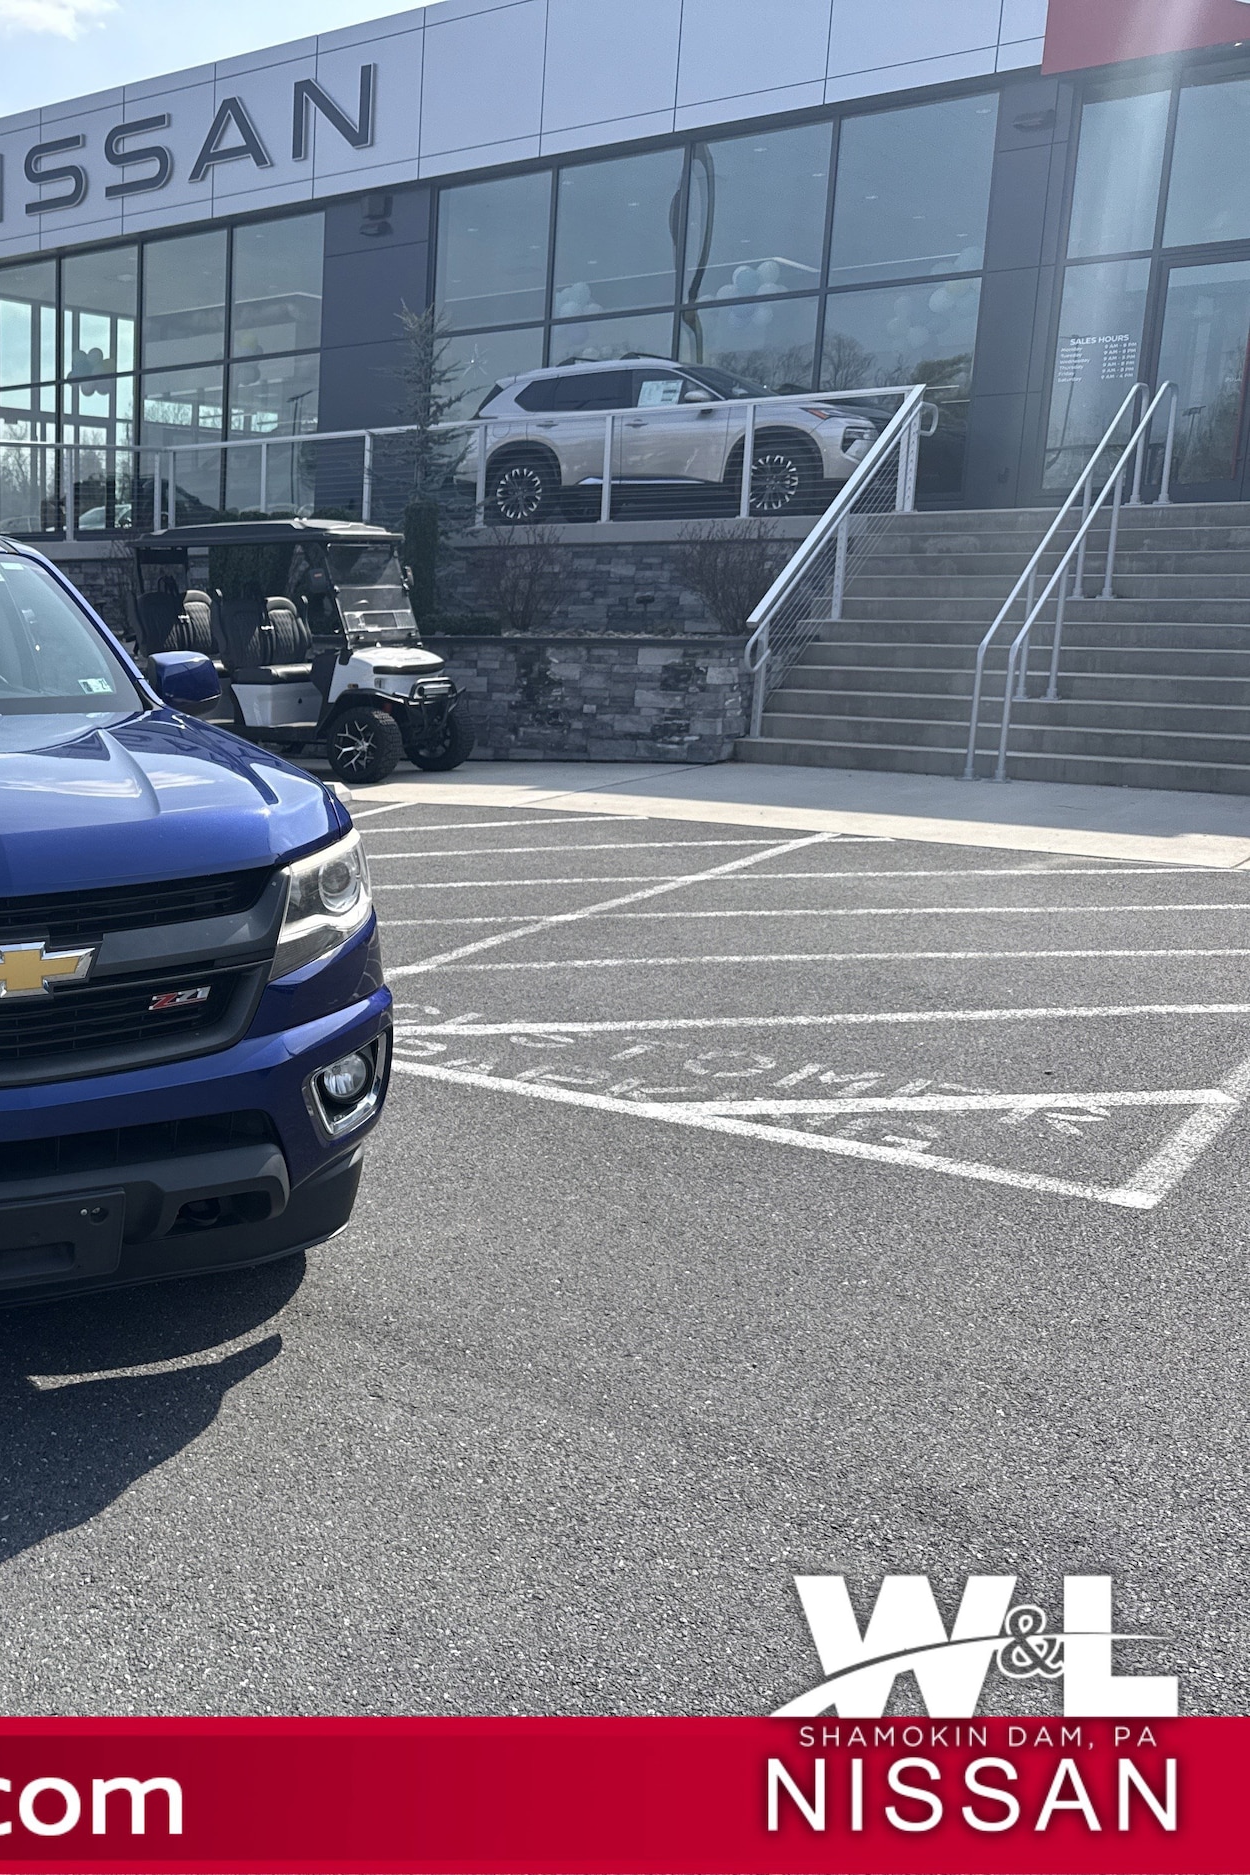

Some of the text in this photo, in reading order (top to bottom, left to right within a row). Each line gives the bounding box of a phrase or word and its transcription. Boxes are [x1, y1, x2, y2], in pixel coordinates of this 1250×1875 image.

[1070, 334, 1129, 345] SALES HOURS
[148, 985, 211, 1010] Z71
